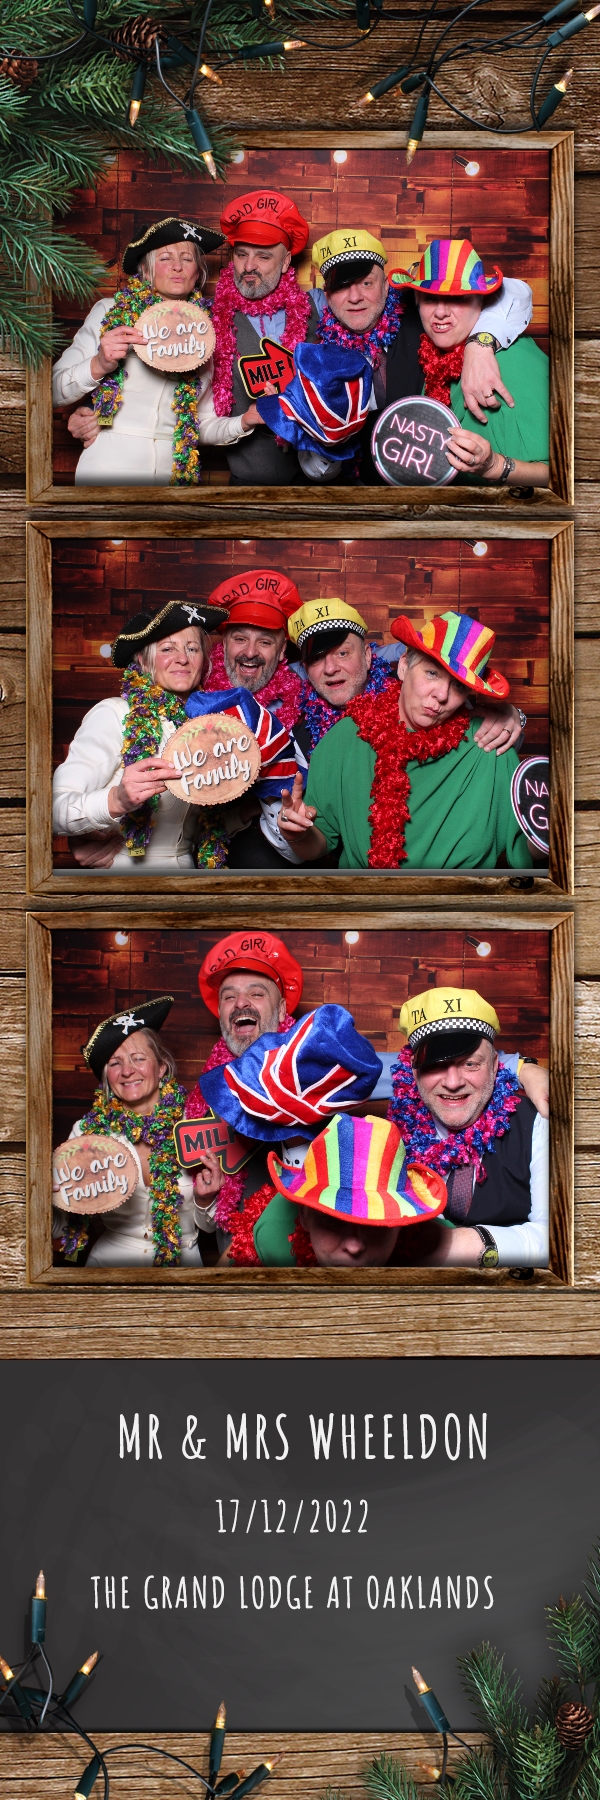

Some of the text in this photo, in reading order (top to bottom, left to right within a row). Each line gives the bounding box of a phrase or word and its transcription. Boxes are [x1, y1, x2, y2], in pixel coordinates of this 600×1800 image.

[256, 198, 280, 213] GIRL
[143, 318, 209, 339] We are
[146, 334, 207, 361] Family
[247, 360, 286, 385] MILF
[390, 413, 452, 451] NASTY
[382, 437, 438, 481] GIRL
[255, 577, 281, 596] GIRL
[173, 735, 252, 770] We are
[180, 753, 252, 796] Family
[241, 938, 267, 953] GIRL
[53, 1152, 128, 1185] We are
[60, 1169, 129, 1206] Family
